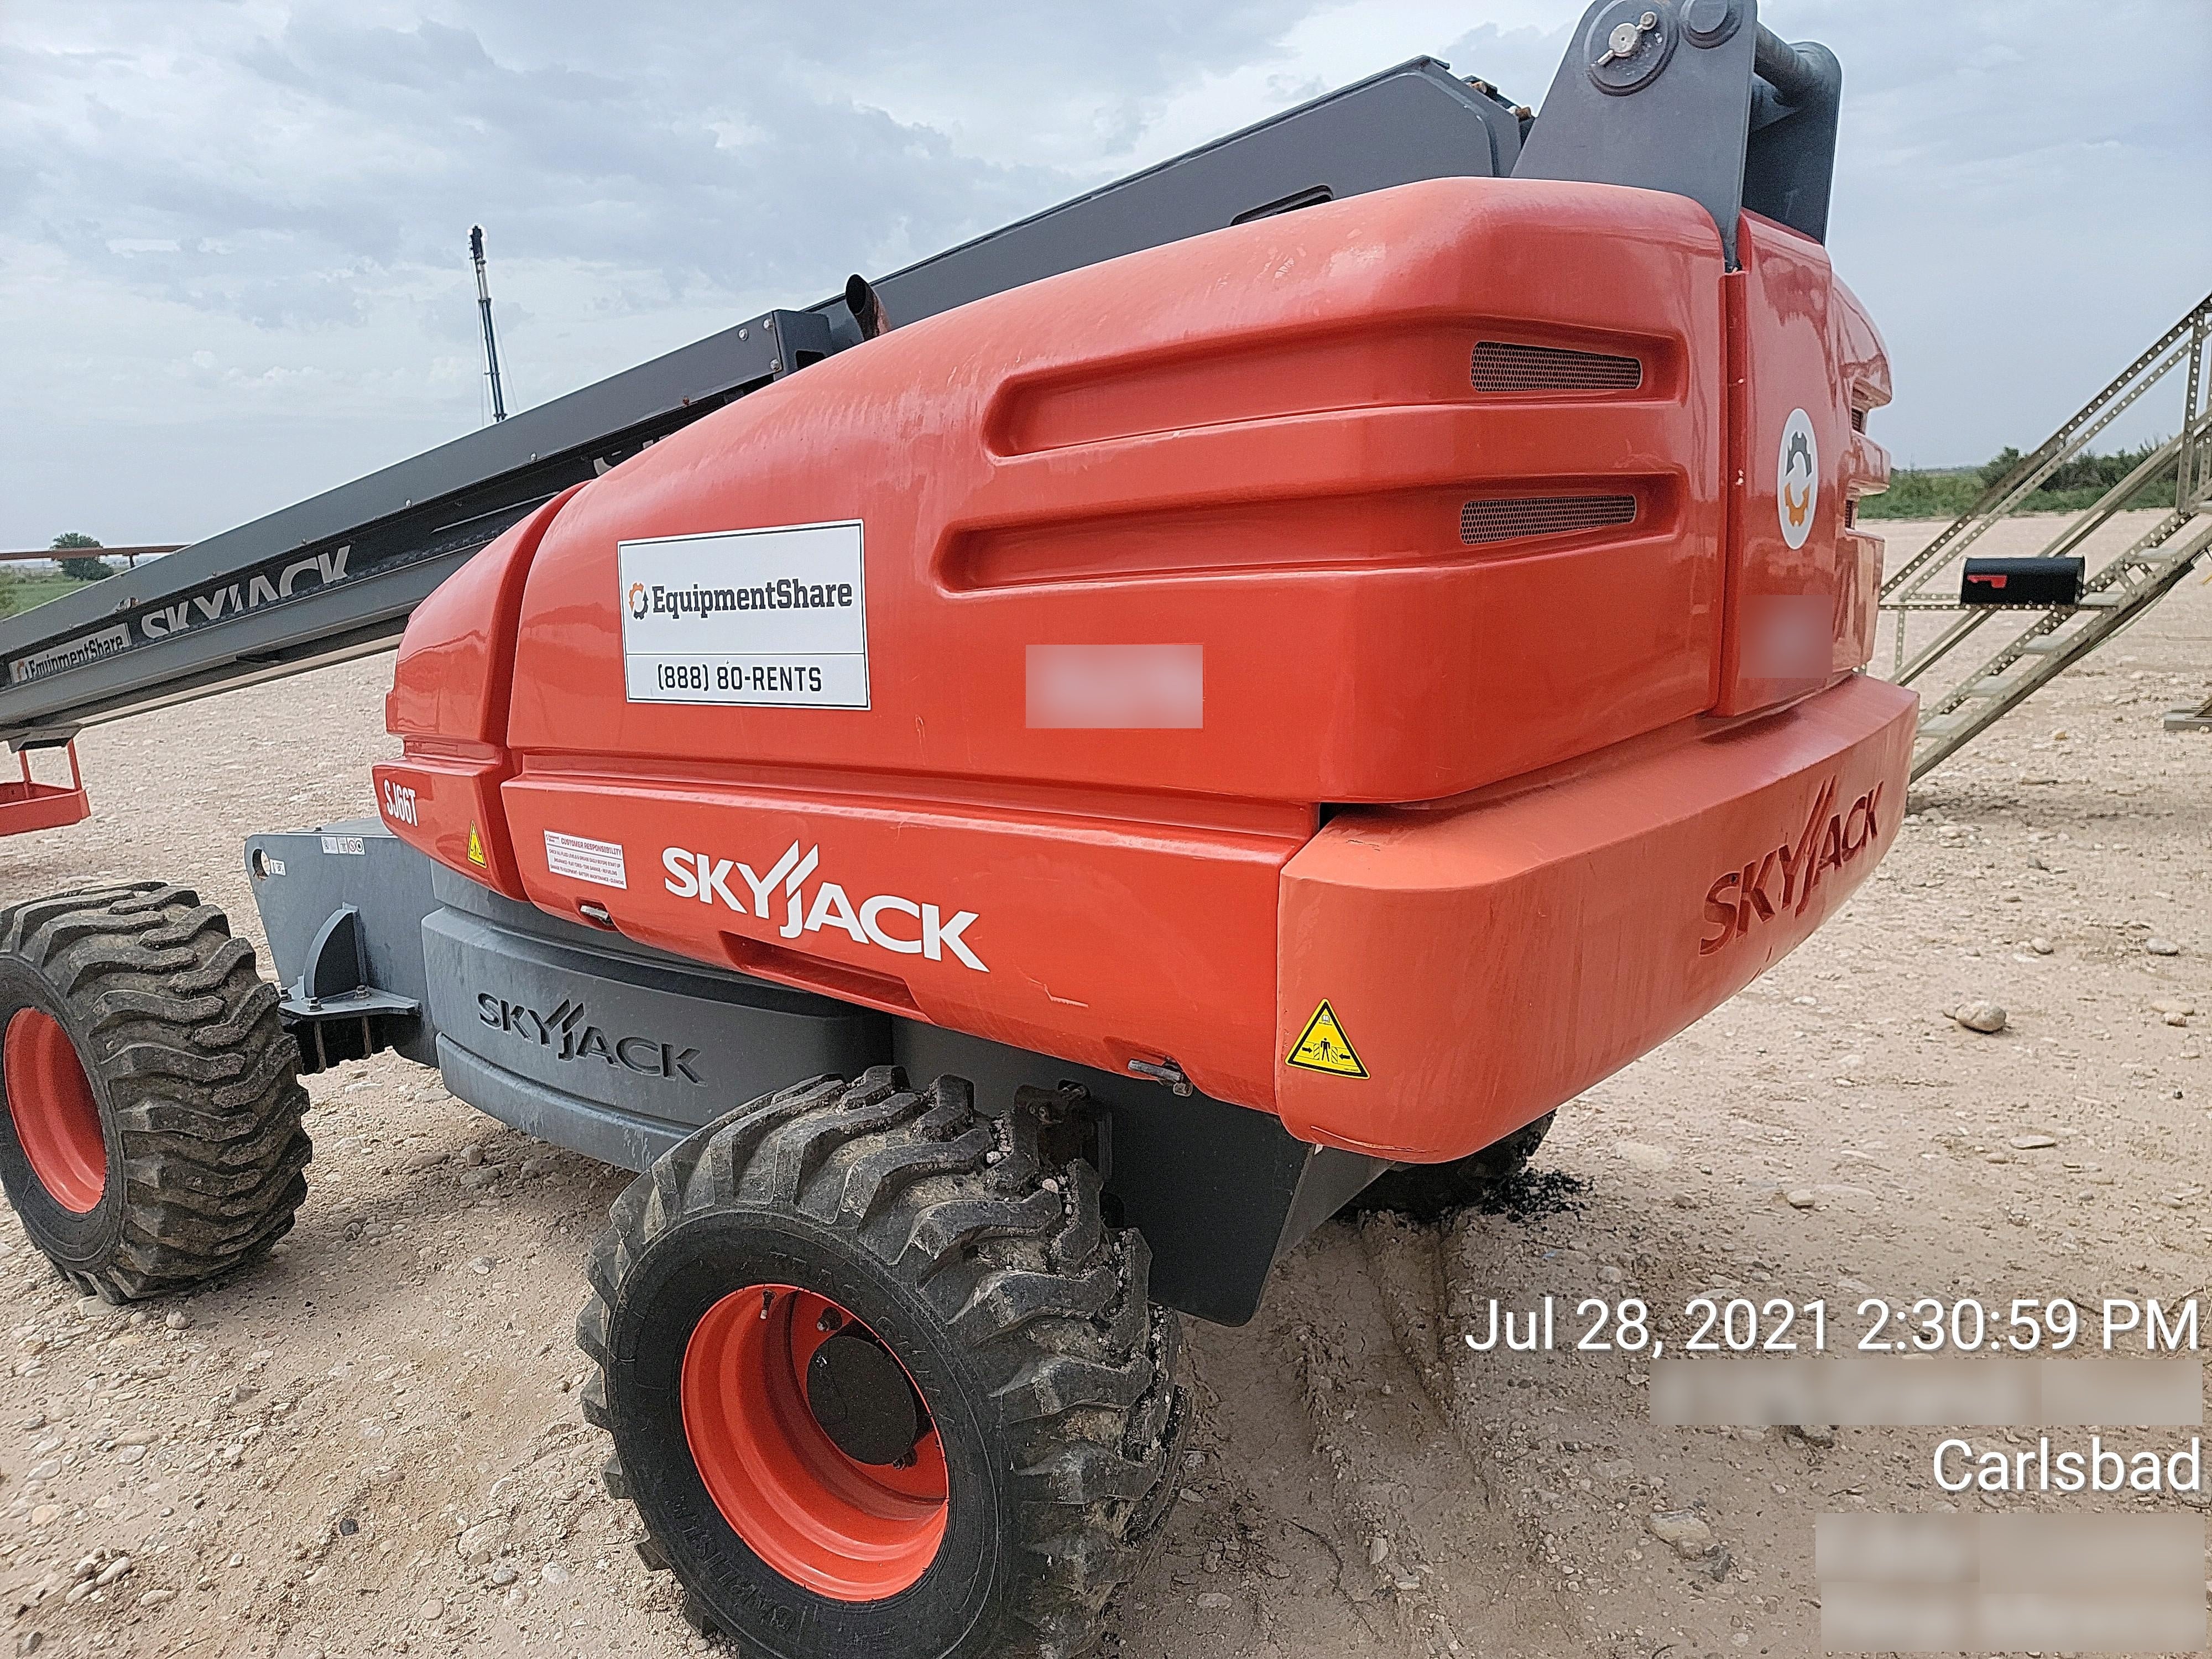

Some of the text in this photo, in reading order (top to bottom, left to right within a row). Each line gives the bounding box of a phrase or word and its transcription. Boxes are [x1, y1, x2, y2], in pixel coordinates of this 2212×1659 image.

[652, 578, 853, 619] EquipmentShare
[658, 664, 822, 692] (888) 80-RENTS
[384, 779, 418, 827] SJ66T
[560, 837, 583, 848] CUSTOMER
[583, 842, 622, 857] RESPONSIBILITY
[1699, 774, 1884, 956] SKYJACK
[661, 839, 990, 973] SKYJACK
[477, 992, 707, 1087] SKYJACK
